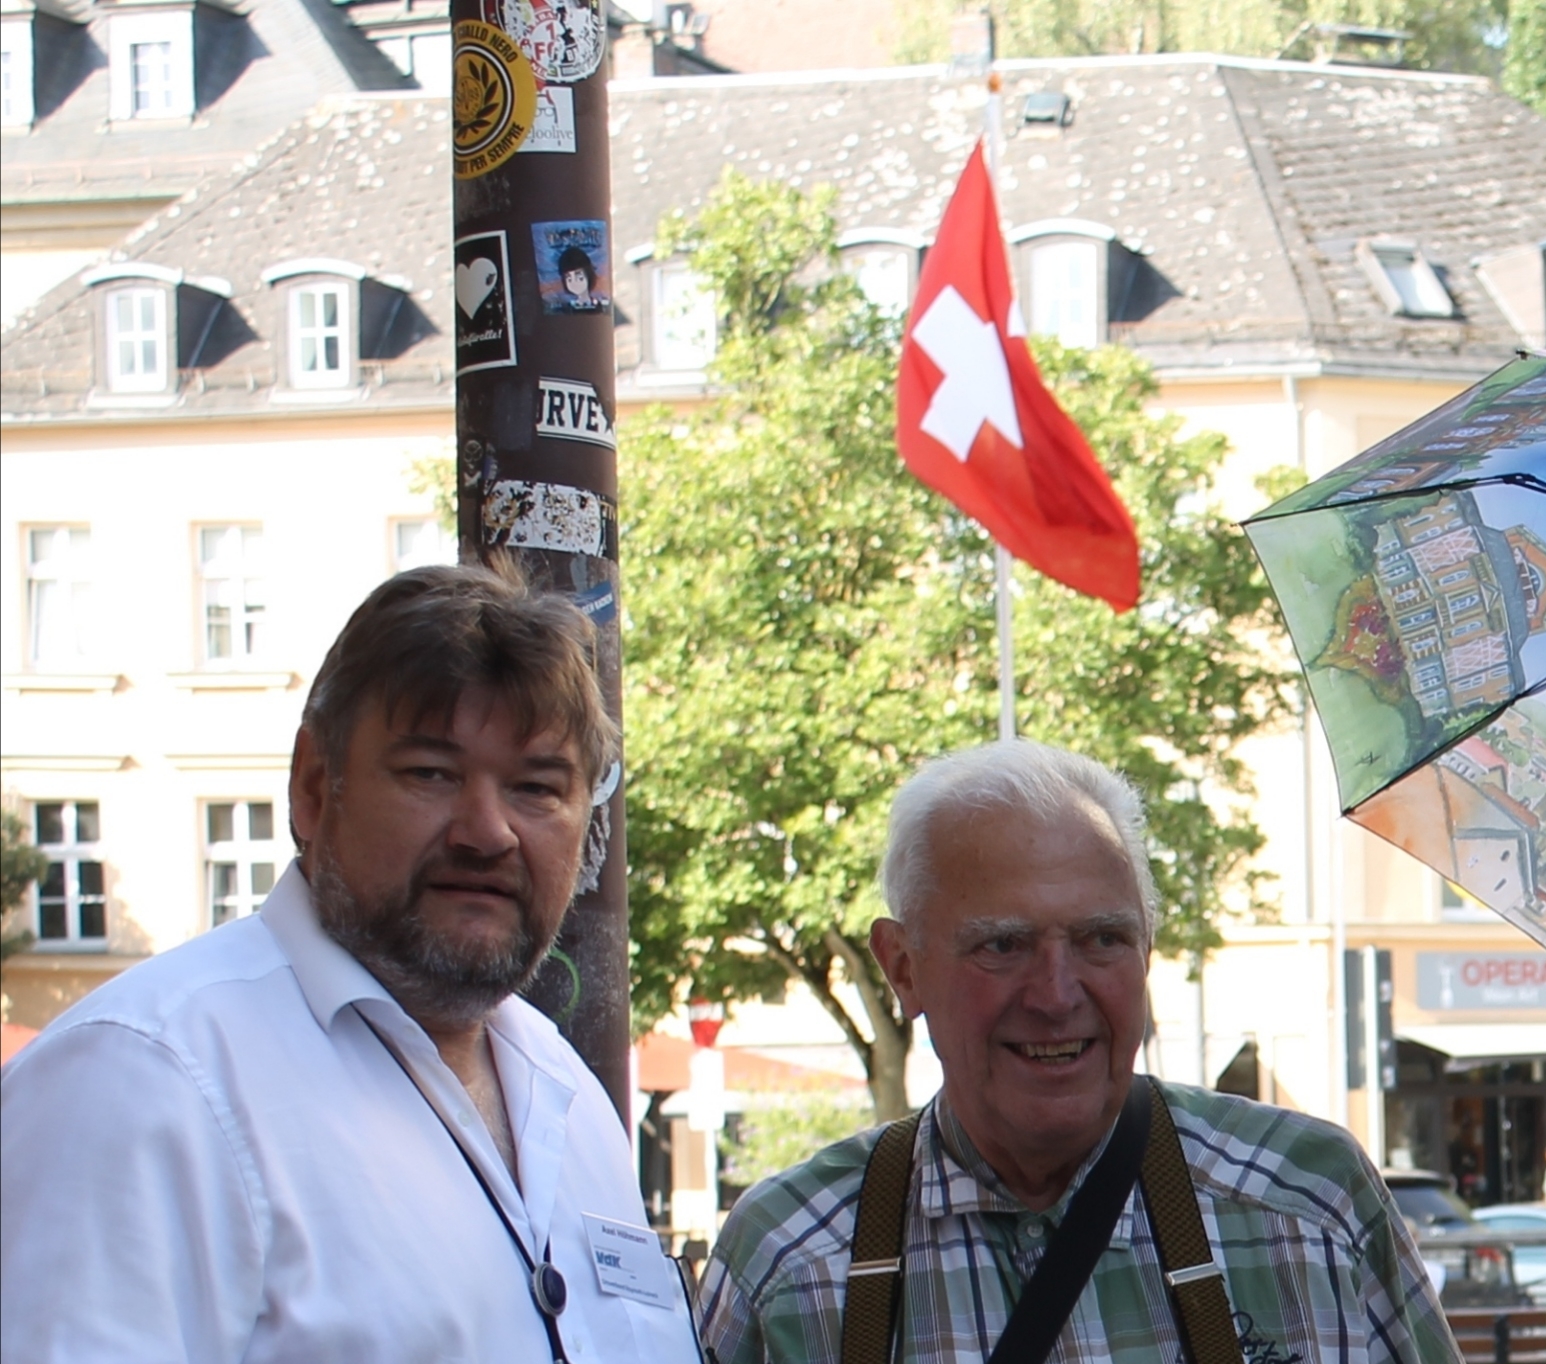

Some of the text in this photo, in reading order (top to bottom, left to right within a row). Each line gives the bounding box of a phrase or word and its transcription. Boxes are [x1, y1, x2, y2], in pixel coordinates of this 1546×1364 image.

[489, 34, 519, 63] NERO
[470, 155, 488, 173] PER
[487, 122, 526, 162] SEMPRE
[595, 1250, 621, 1269] VdK
